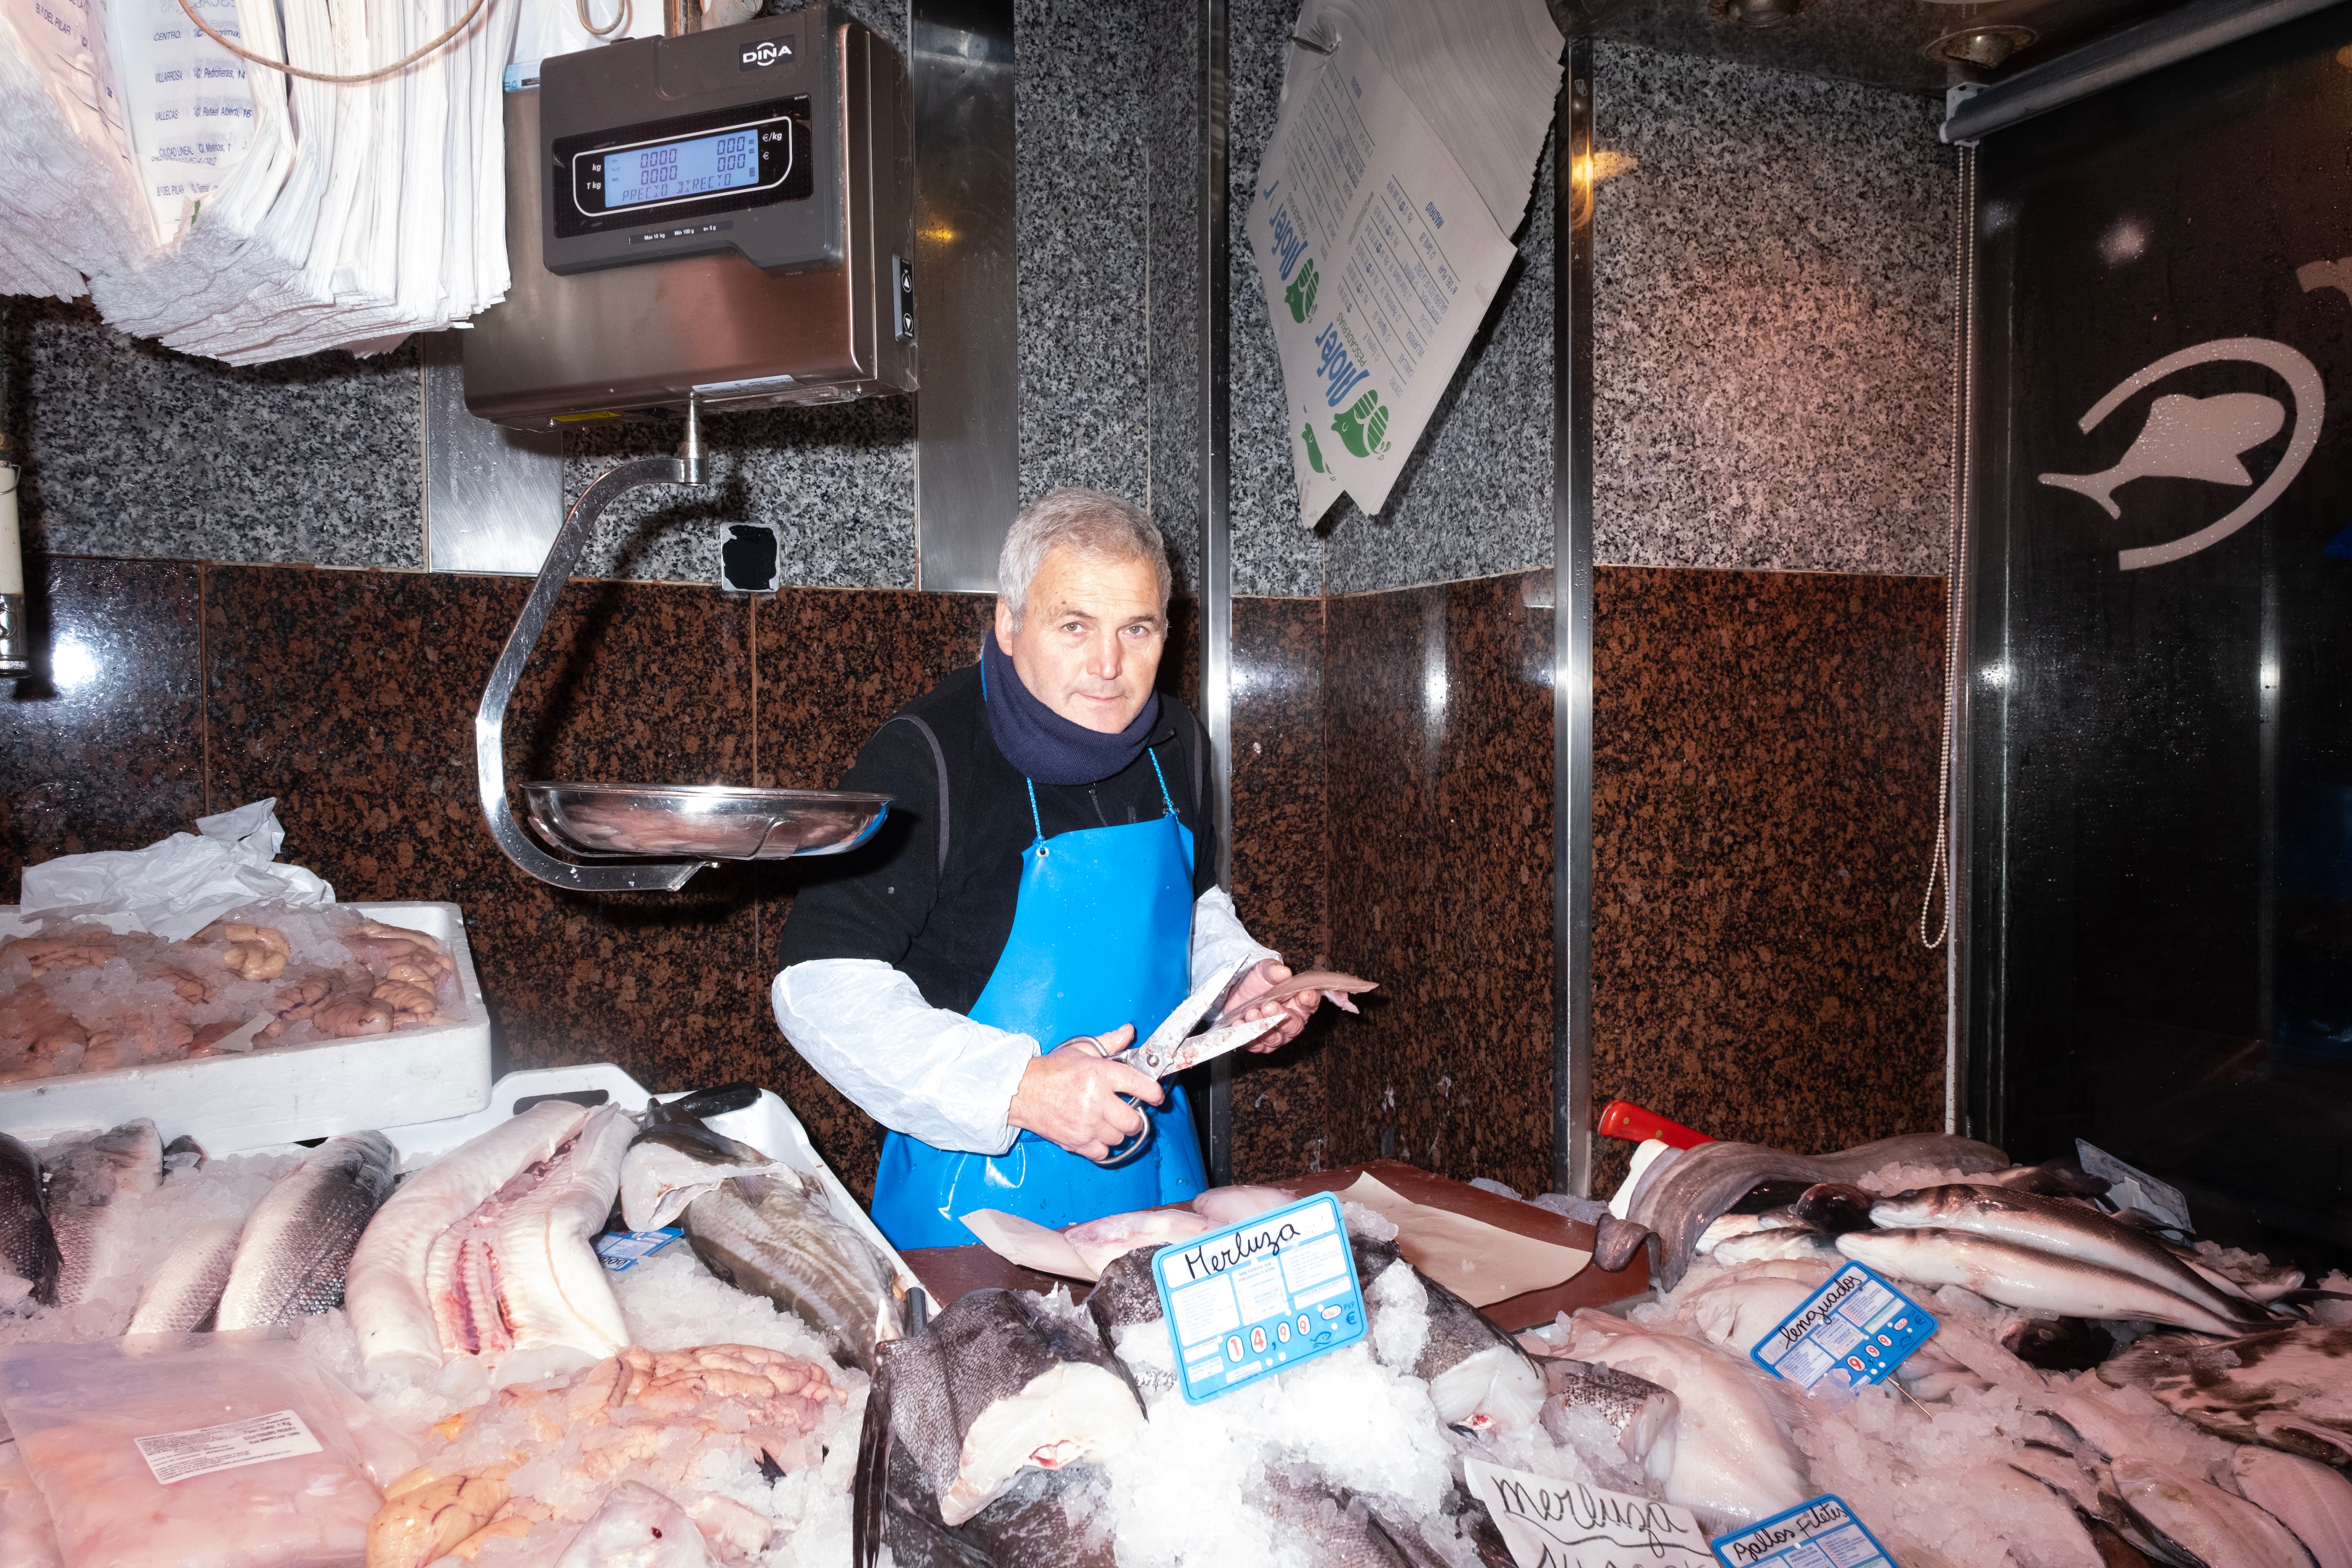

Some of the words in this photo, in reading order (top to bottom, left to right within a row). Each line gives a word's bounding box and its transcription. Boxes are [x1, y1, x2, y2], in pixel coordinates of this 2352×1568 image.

[44, 9, 54, 25] DEL
[55, 17, 71, 36] PILAR
[154, 31, 182, 41] CENTRO:
[743, 45, 792, 63] DINA
[155, 70, 184, 83] VILLARROSA:
[204, 68, 234, 79] Pedroñeras,
[238, 69, 246, 79] 14
[203, 106, 219, 116] Rafael
[243, 109, 252, 118] 16
[762, 130, 782, 142] €/kg
[177, 146, 194, 156] LINEAL
[763, 151, 770, 159] €
[172, 182, 184, 195] PILAR
[622, 183, 667, 202] PRECIO
[677, 173, 731, 193] DIRECTO
[1286, 191, 1307, 239] PESCADERIAS
[1424, 201, 1445, 229] MADRID
[1437, 263, 1448, 279] PILAR
[1424, 278, 1431, 288] DE
[1444, 275, 1454, 288] DEL
[1433, 292, 1447, 313] GALERIA
[1335, 311, 1367, 367] PESCADERIAS
[1185, 1224, 1301, 1280] Merluza
[1323, 1308, 1339, 1318] KILO
[1343, 1301, 1356, 1312] P.V.P.
[1778, 1275, 1862, 1349] lenguados
[1345, 1311, 1357, 1324] €
[1896, 1318, 1908, 1329] KILO
